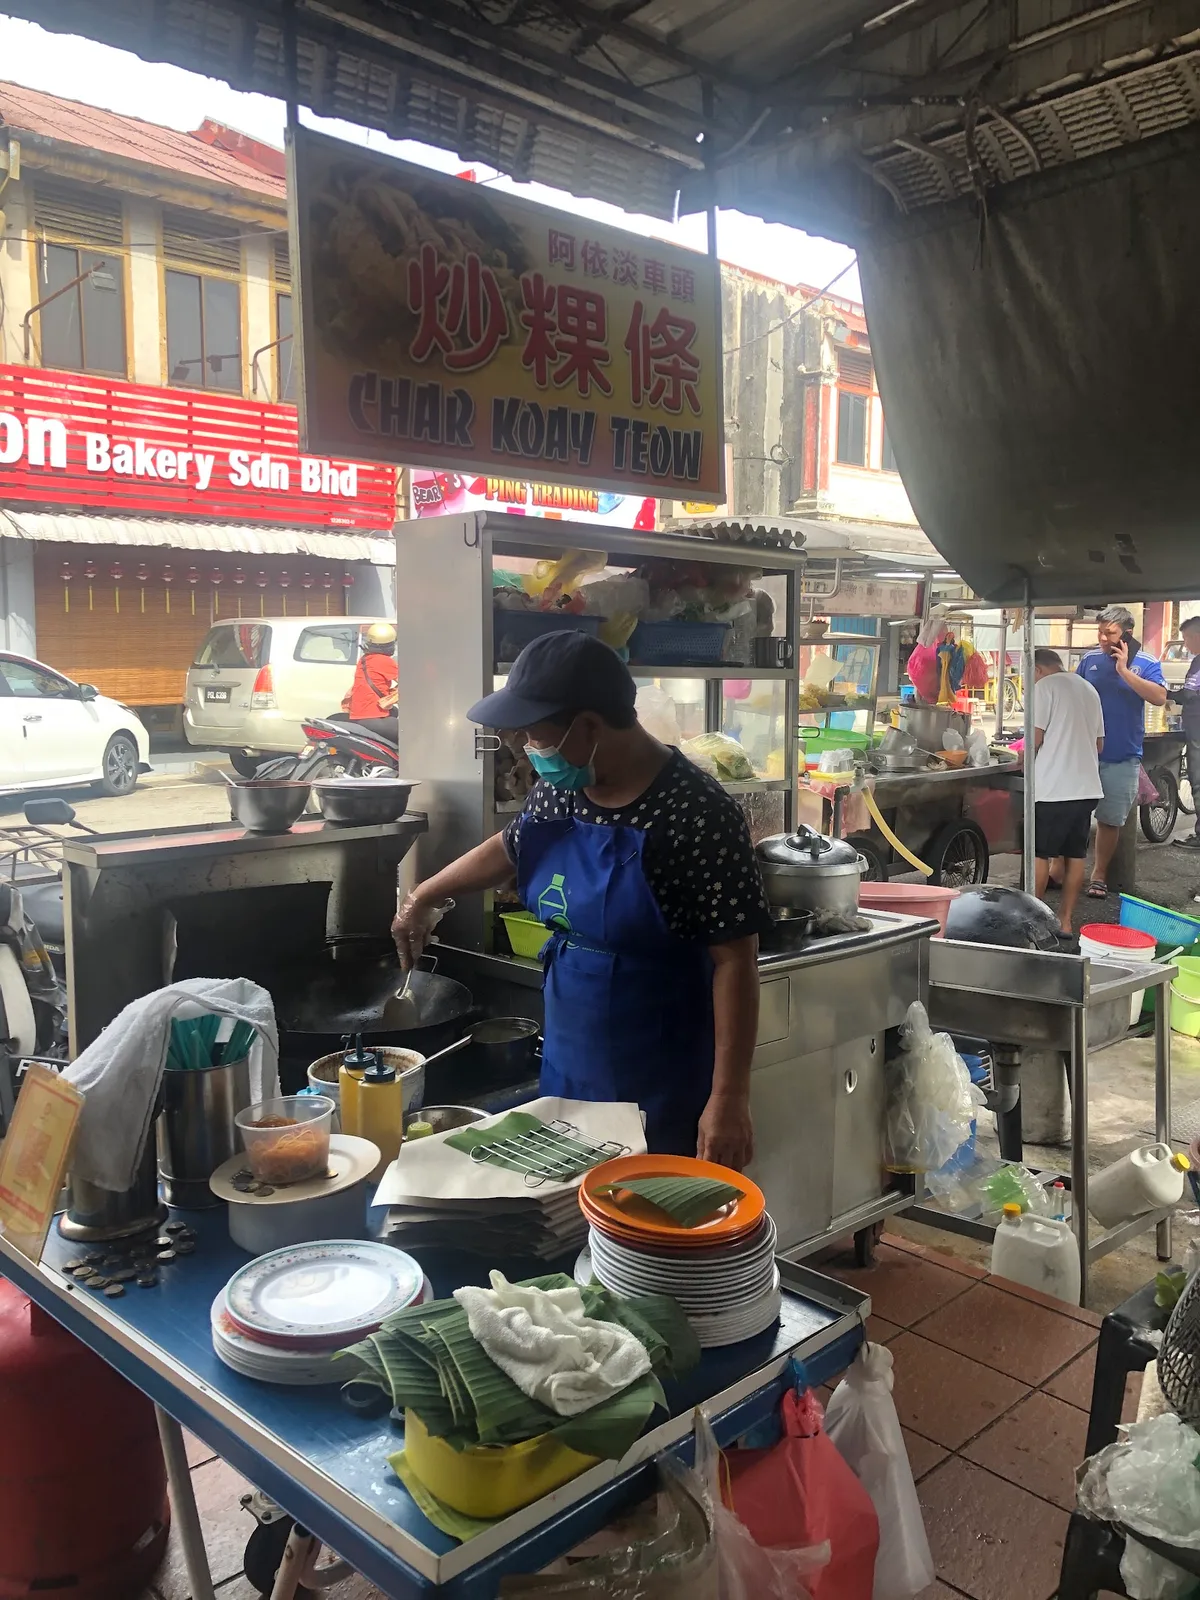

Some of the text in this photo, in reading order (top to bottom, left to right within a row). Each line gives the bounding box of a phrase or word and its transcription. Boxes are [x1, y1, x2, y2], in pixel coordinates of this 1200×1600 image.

[547, 228, 697, 302] 阿依淡車頭
[407, 243, 701, 415] 炒粿條
[348, 371, 703, 481] CHAR KOAY TEOW
[86, 432, 215, 490] Bakery
[228, 450, 289, 491] Sdn
[301, 458, 357, 497] Bhd
[412, 485, 442, 505] BEAR
[485, 477, 599, 513] PING TRADING
